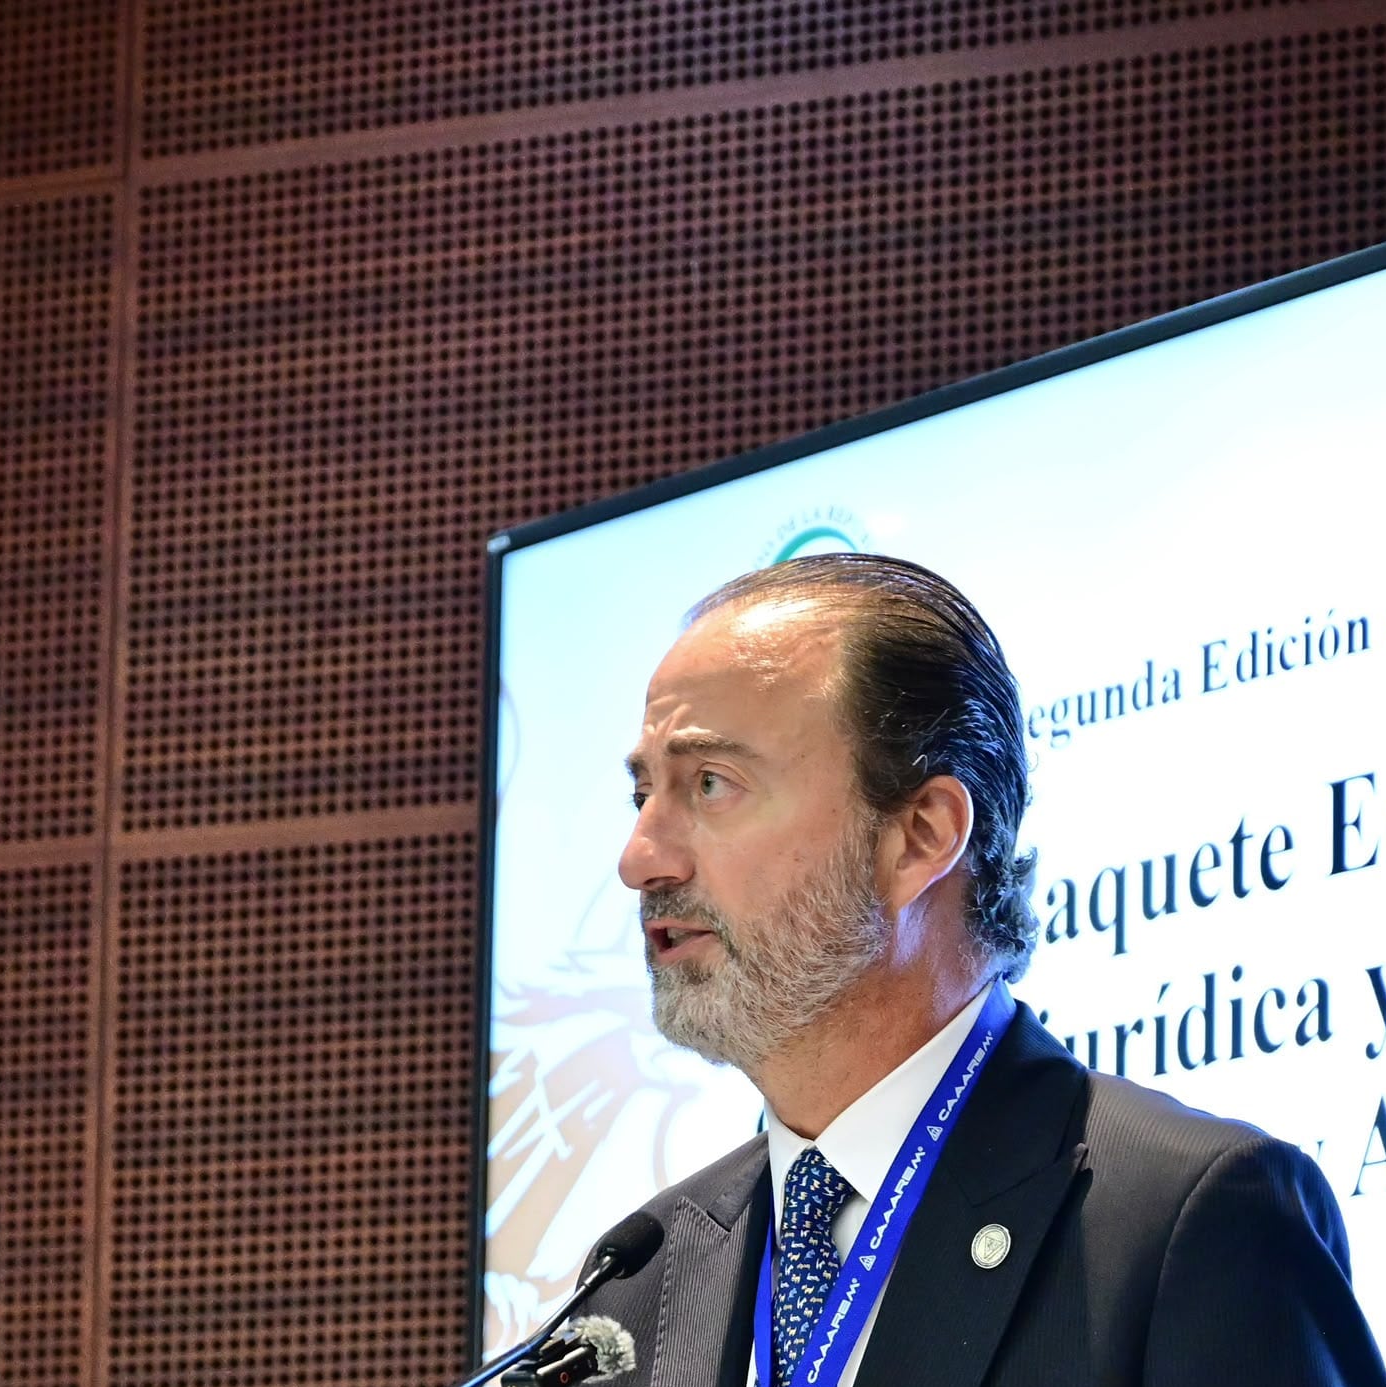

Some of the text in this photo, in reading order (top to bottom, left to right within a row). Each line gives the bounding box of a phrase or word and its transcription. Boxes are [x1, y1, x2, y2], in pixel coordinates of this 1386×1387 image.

[1028, 659, 1181, 749] egunda
[1202, 609, 1371, 694] Edición
[1045, 815, 1295, 957] aquete
[1040, 965, 1333, 1076] urídica
